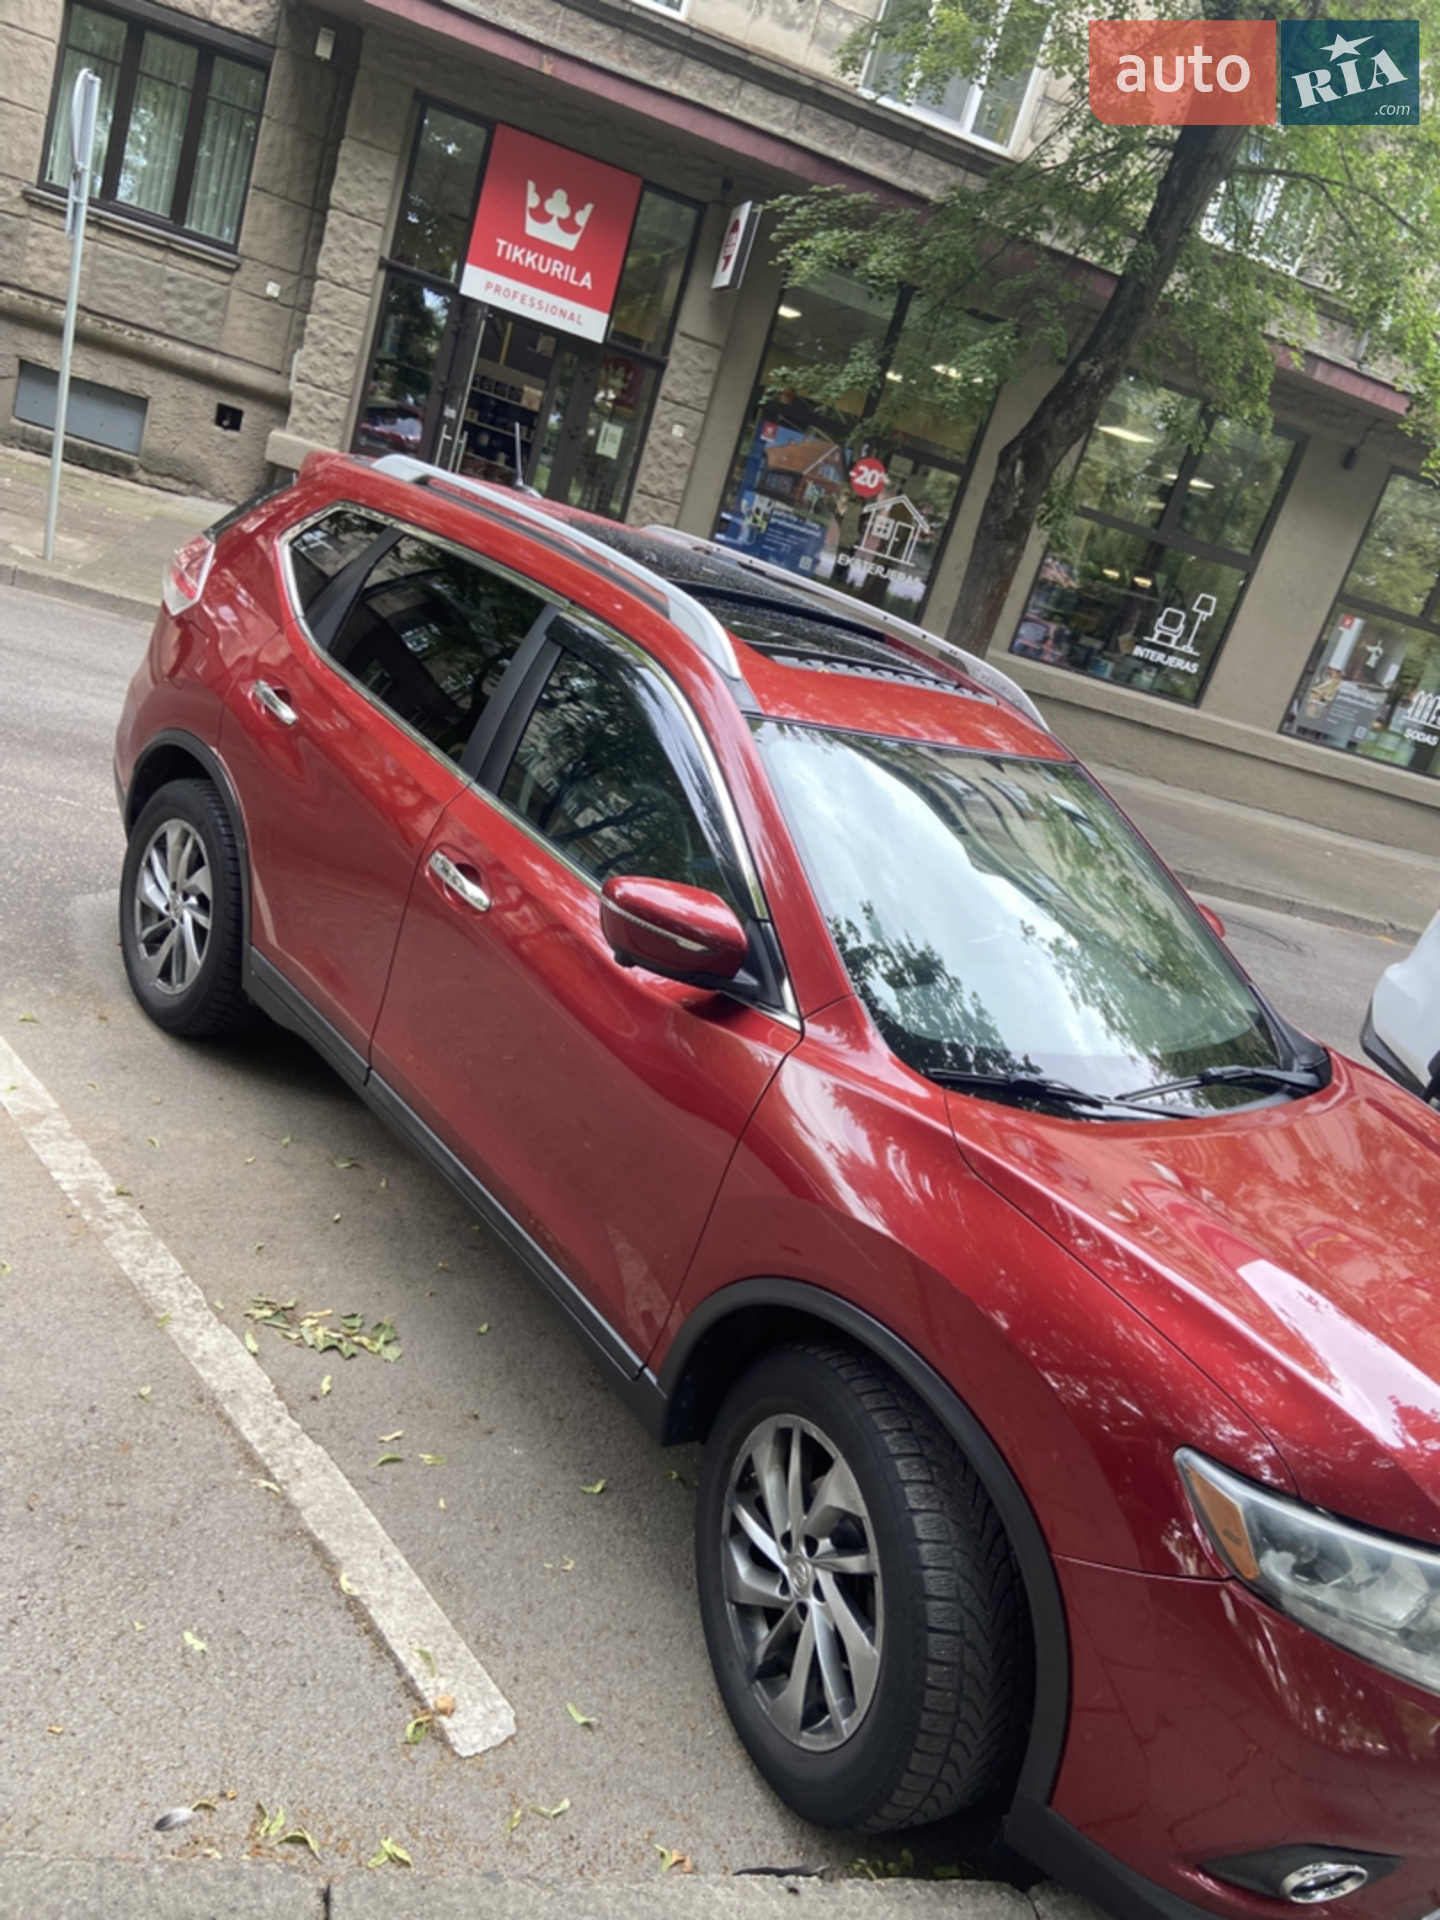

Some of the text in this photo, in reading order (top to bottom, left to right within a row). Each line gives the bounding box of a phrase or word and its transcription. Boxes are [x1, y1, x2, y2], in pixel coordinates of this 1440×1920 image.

[495, 238, 592, 290] TIKKURILA
[484, 281, 584, 326] PROFESSIONAL
[837, 553, 922, 586] EKSTERJERAS
[1132, 645, 1199, 675] INTERJERAS
[1404, 728, 1439, 746] SODAS
